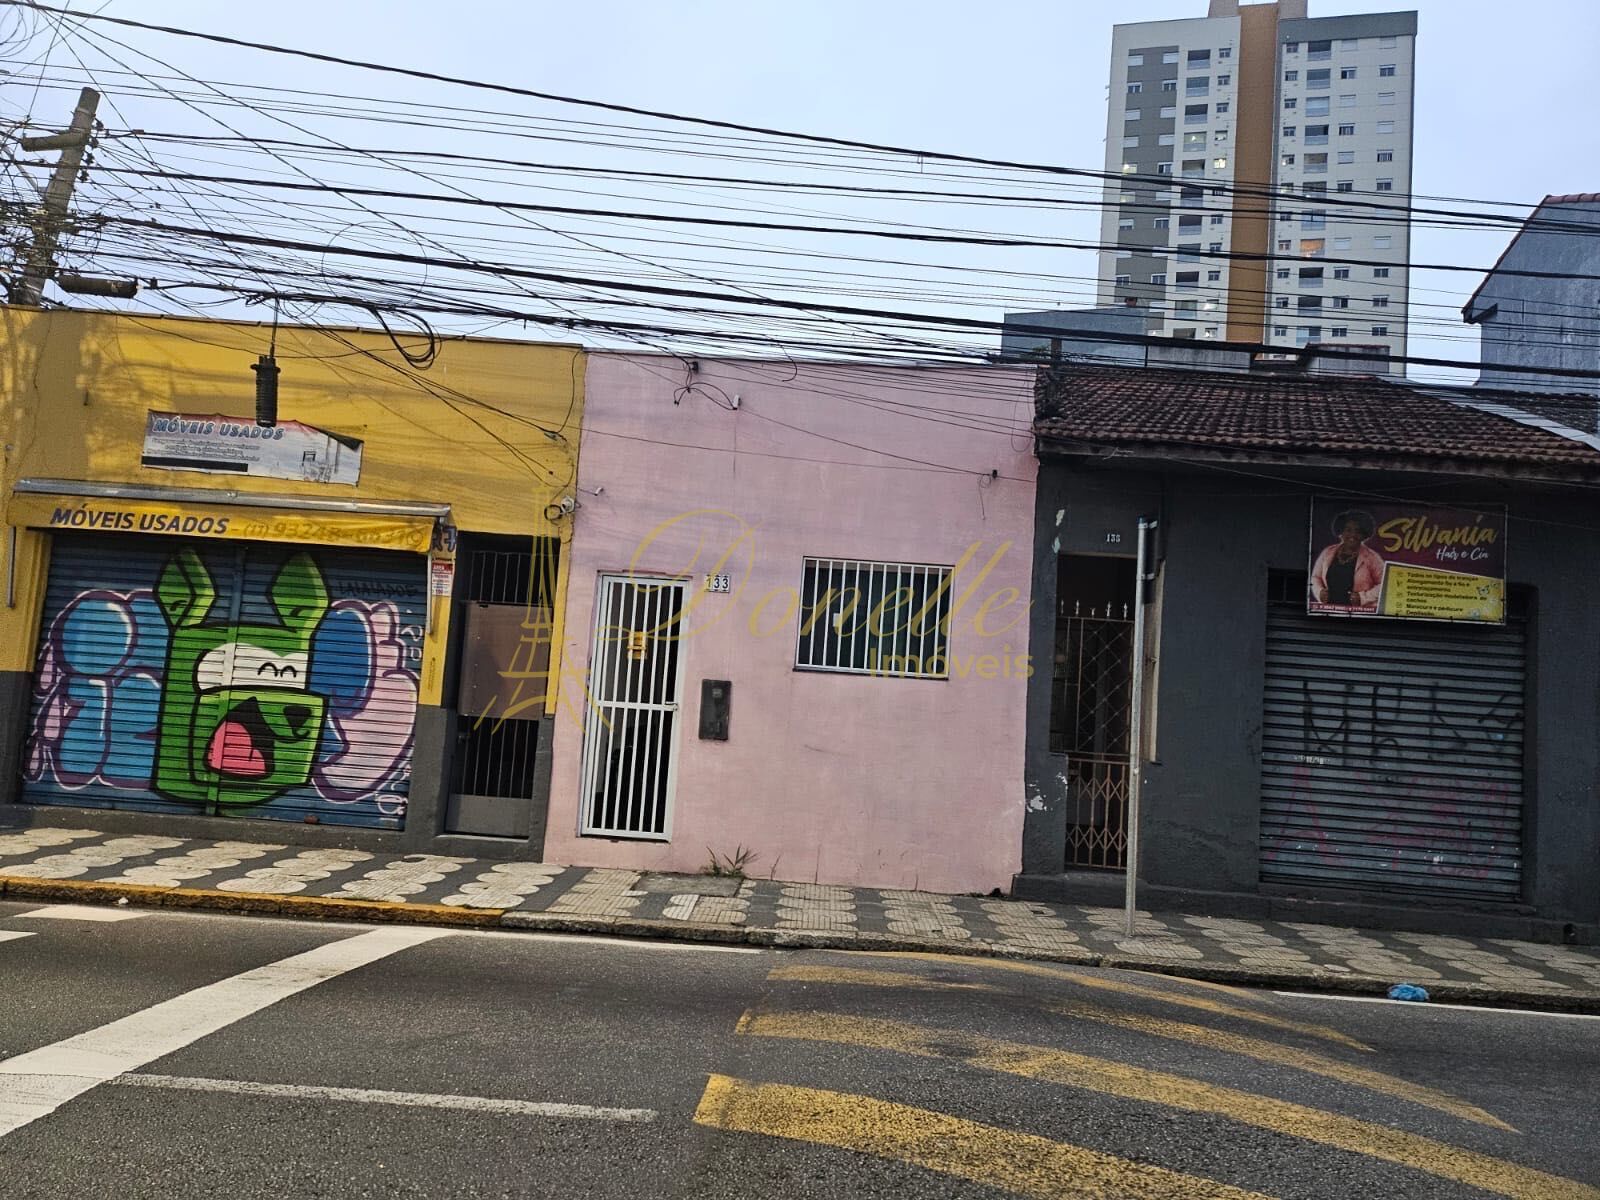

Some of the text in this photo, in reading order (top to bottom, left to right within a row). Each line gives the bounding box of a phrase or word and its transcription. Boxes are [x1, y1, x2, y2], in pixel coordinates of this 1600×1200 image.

[152, 415, 285, 441] MÓVEIS USADOS
[50, 502, 135, 530] MÓVEIS
[139, 513, 230, 534] USADOS
[1377, 514, 1498, 553] Silvania
[705, 577, 729, 589] 133
